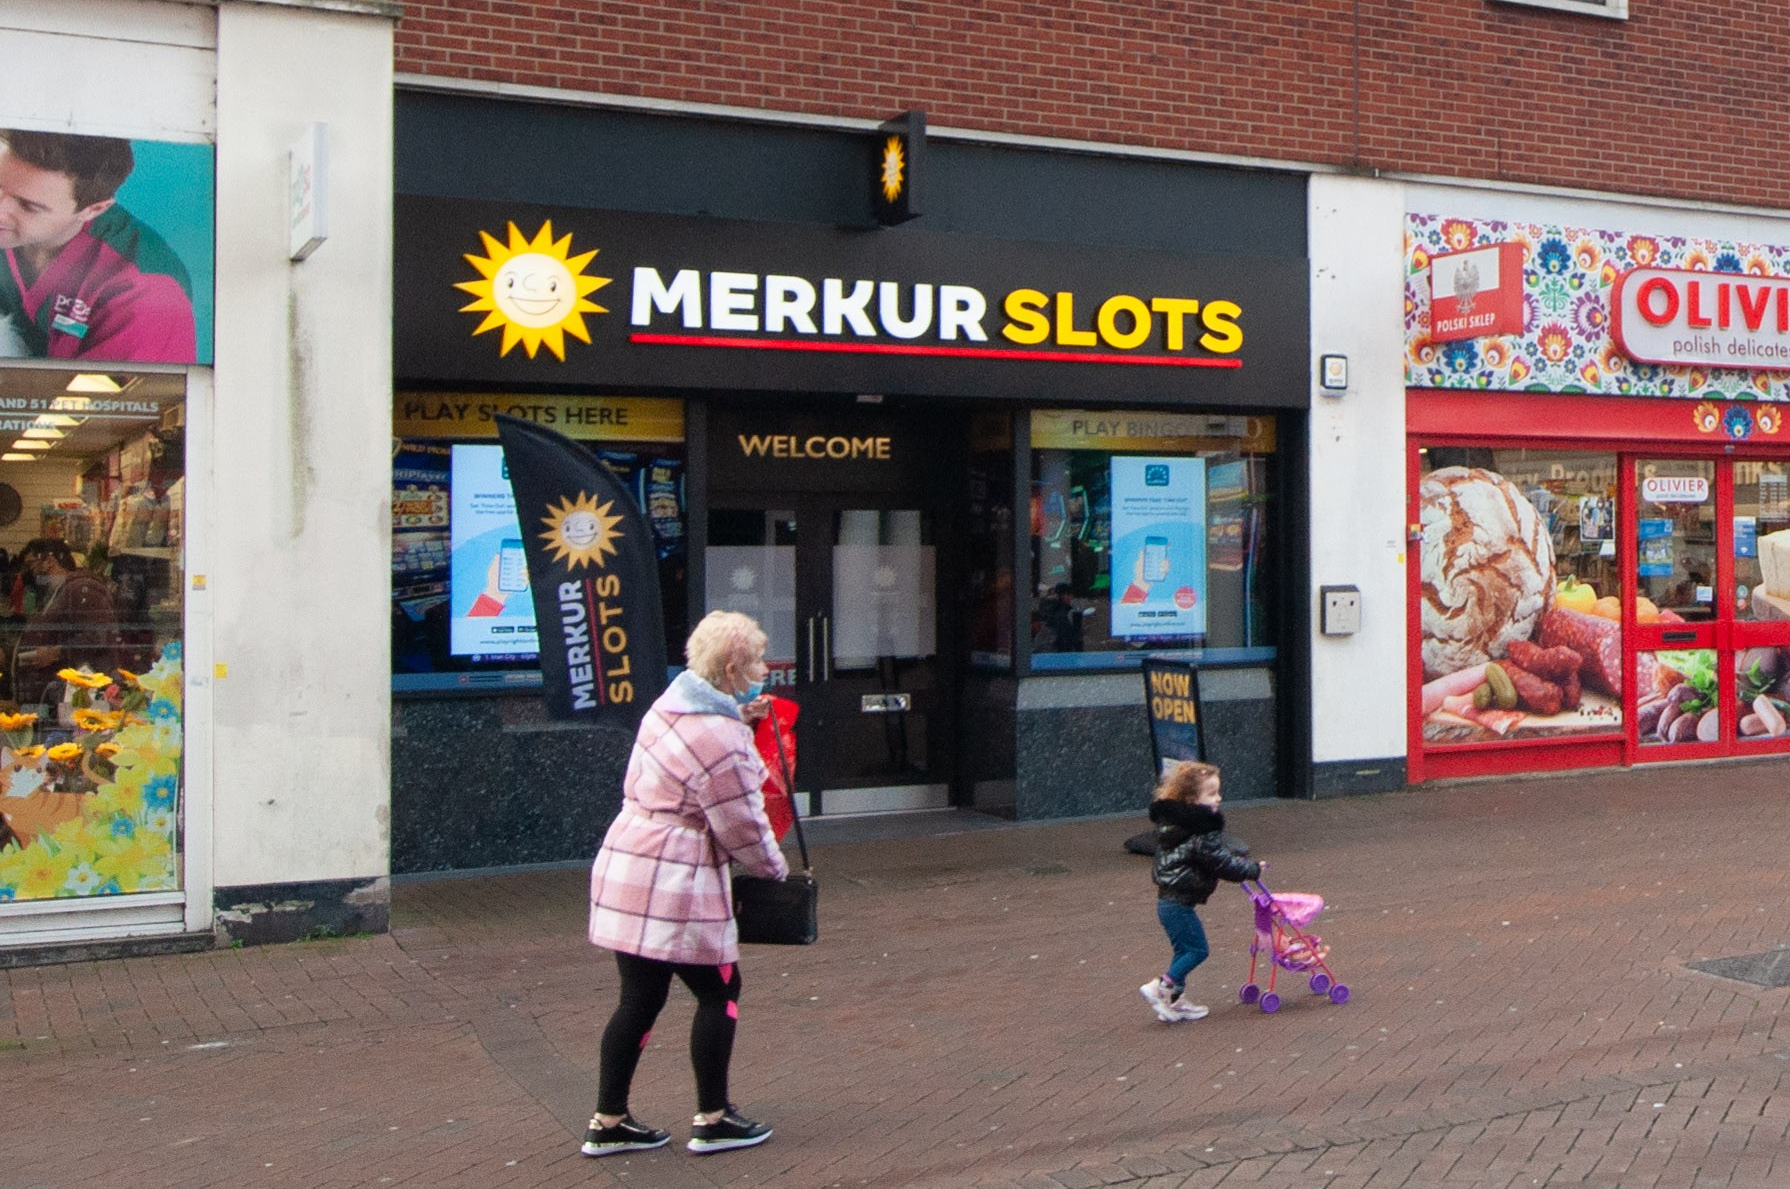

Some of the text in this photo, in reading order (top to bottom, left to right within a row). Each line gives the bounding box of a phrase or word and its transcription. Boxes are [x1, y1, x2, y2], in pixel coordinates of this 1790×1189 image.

[631, 267, 1244, 354] MERKUR SLOTS
[1437, 313, 1496, 332] POLSKI SKLEP
[1673, 336, 1721, 356] polish
[0, 398, 159, 412] AND 51 PET HOSPITALS
[404, 400, 471, 422] PLAY
[565, 407, 628, 426] HERE
[0, 419, 55, 430] ATIONS
[1072, 419, 1121, 436] PLAY
[738, 434, 891, 459] WELCOME
[1646, 479, 1705, 493] OLIVIER
[558, 573, 635, 710] MERKUR SLOTS
[1150, 671, 1190, 697] NOW
[1152, 696, 1197, 724] OPEN
